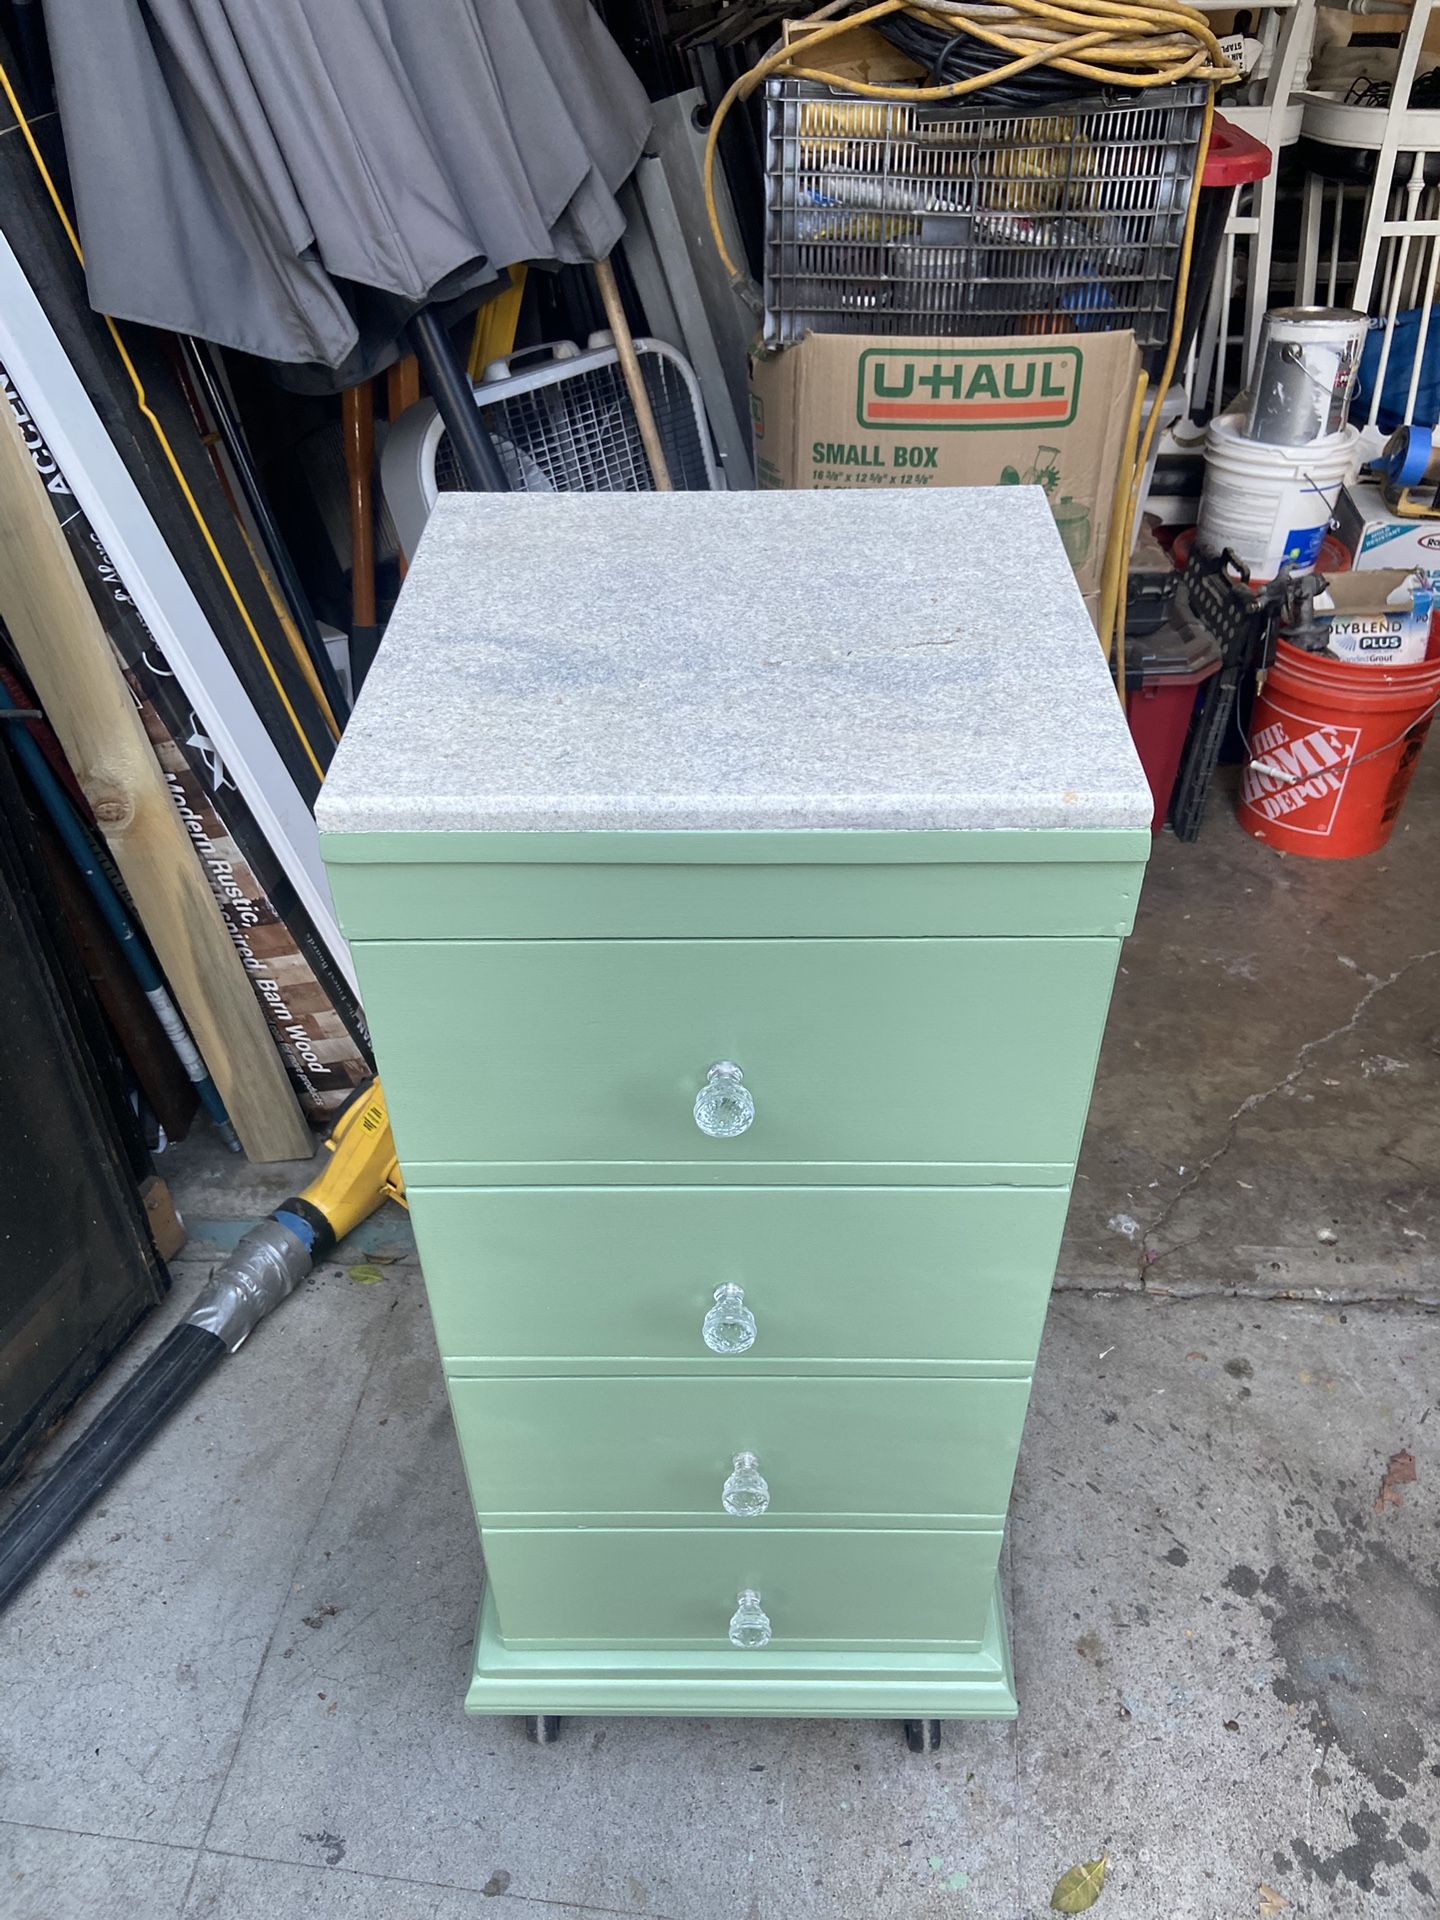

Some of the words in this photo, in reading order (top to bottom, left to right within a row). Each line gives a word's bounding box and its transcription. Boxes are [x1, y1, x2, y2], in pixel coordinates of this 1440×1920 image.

[1221, 42, 1243, 52] STAPL
[873, 361, 1066, 399] U-HAUL
[812, 442, 885, 467] SMALL
[893, 446, 938, 468] BOX
[1327, 620, 1402, 635] OLYBLEND
[1362, 637, 1399, 648] PLUS
[1369, 654, 1393, 662] Grout
[1251, 722, 1290, 755] THE
[1243, 727, 1353, 804] HOME
[1261, 768, 1342, 819] DEPOT
[163, 772, 217, 855] Modern
[207, 857, 260, 929] Rustic,
[255, 978, 293, 1021] Barn
[285, 1024, 330, 1072] Wood
[298, 1072, 324, 1106] products
